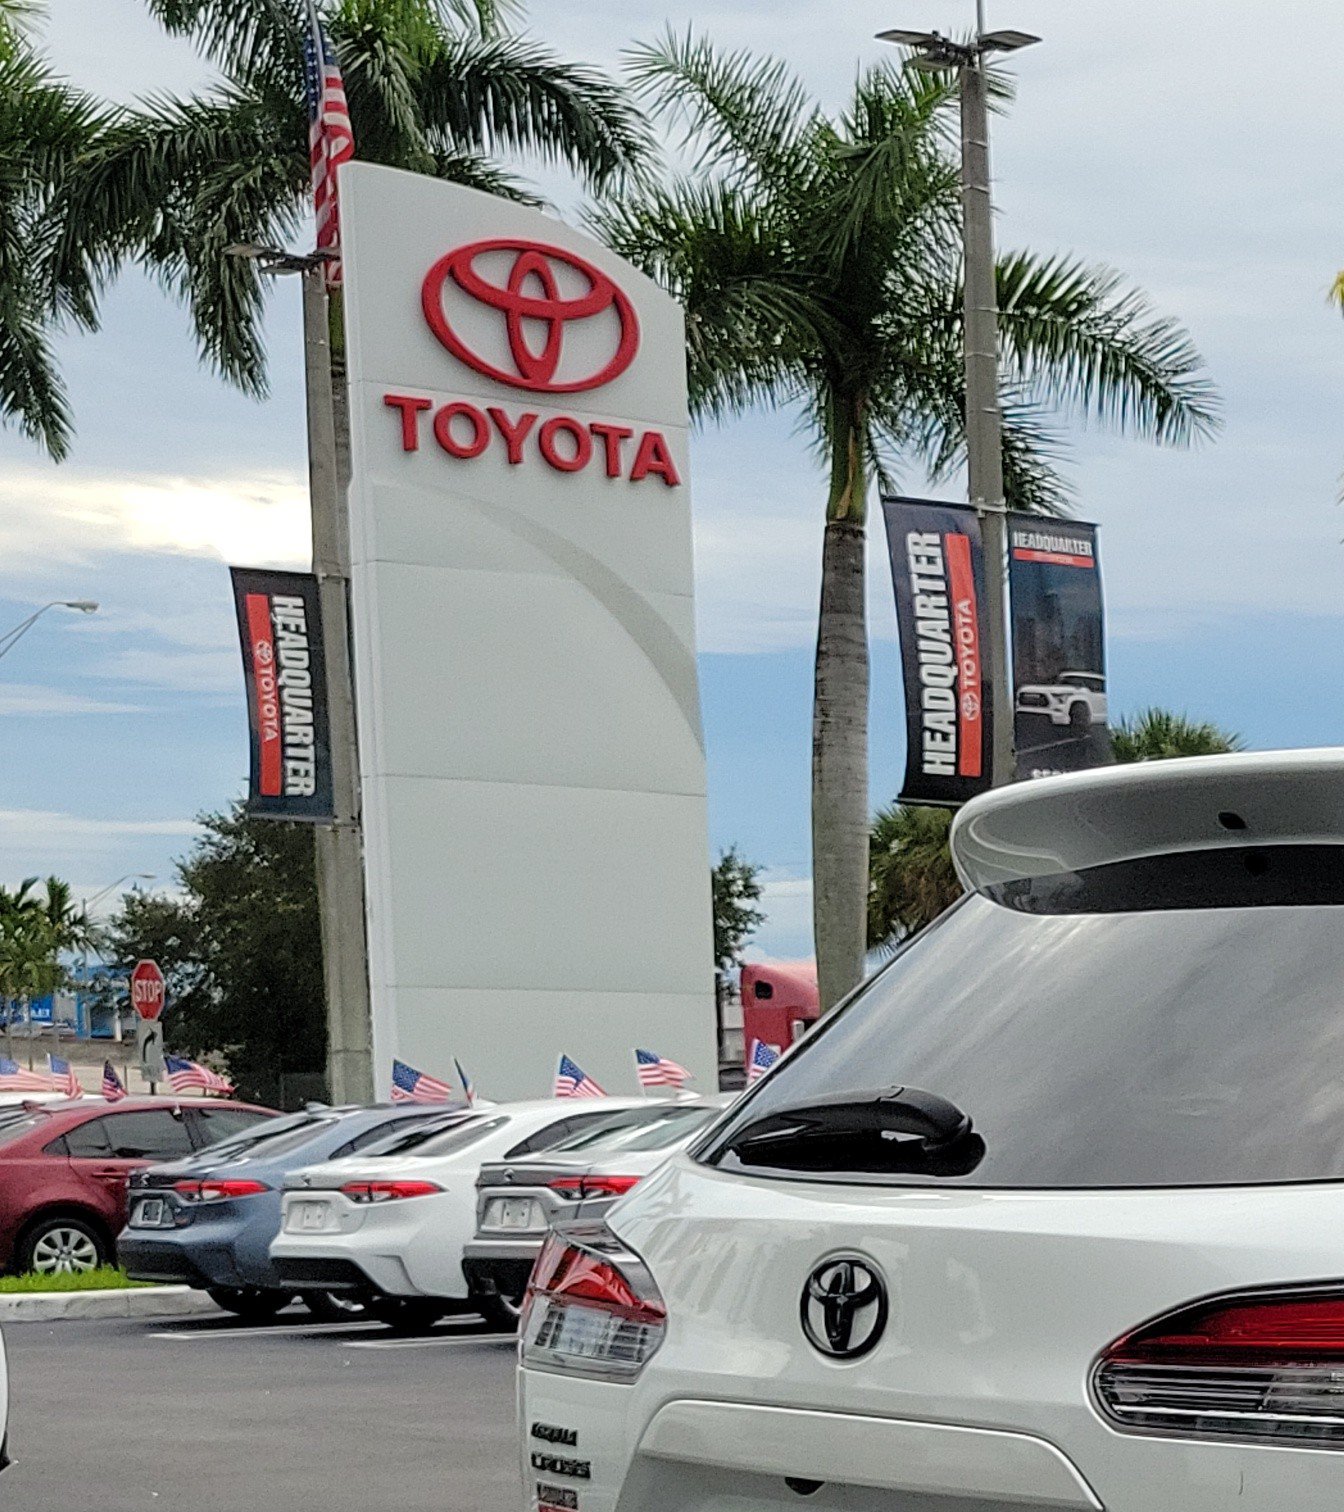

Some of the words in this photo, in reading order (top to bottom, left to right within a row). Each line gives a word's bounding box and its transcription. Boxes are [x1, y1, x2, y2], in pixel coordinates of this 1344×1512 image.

[384, 394, 682, 487] TOYOTA
[907, 531, 958, 776] HEADQUARTER
[957, 599, 978, 690] TOYOTA
[257, 666, 279, 743] TOYOTA
[272, 595, 316, 797] HEADQUARTER
[135, 980, 162, 1003] STOP
